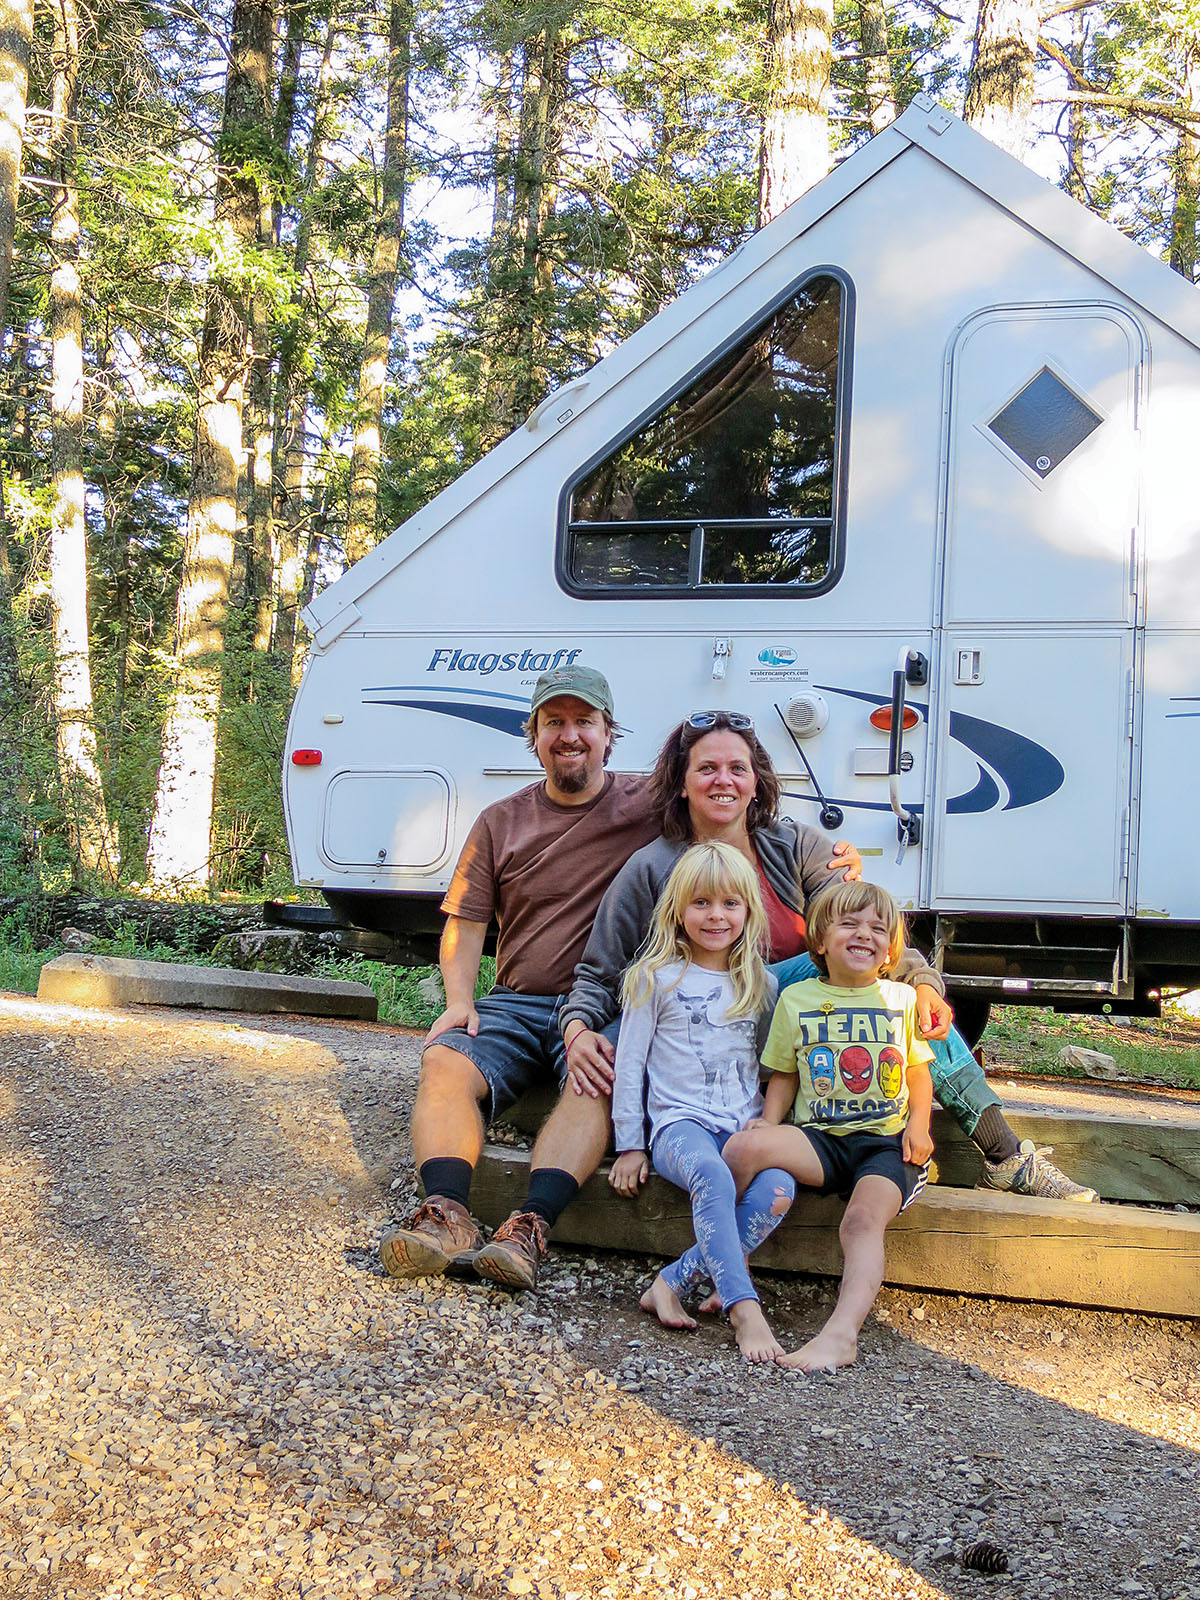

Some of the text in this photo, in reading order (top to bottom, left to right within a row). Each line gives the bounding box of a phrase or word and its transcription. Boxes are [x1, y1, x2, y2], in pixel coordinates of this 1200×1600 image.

[426, 648, 582, 675] Flagstaff
[800, 1014, 903, 1045] TEAM
[814, 1054, 828, 1067] A
